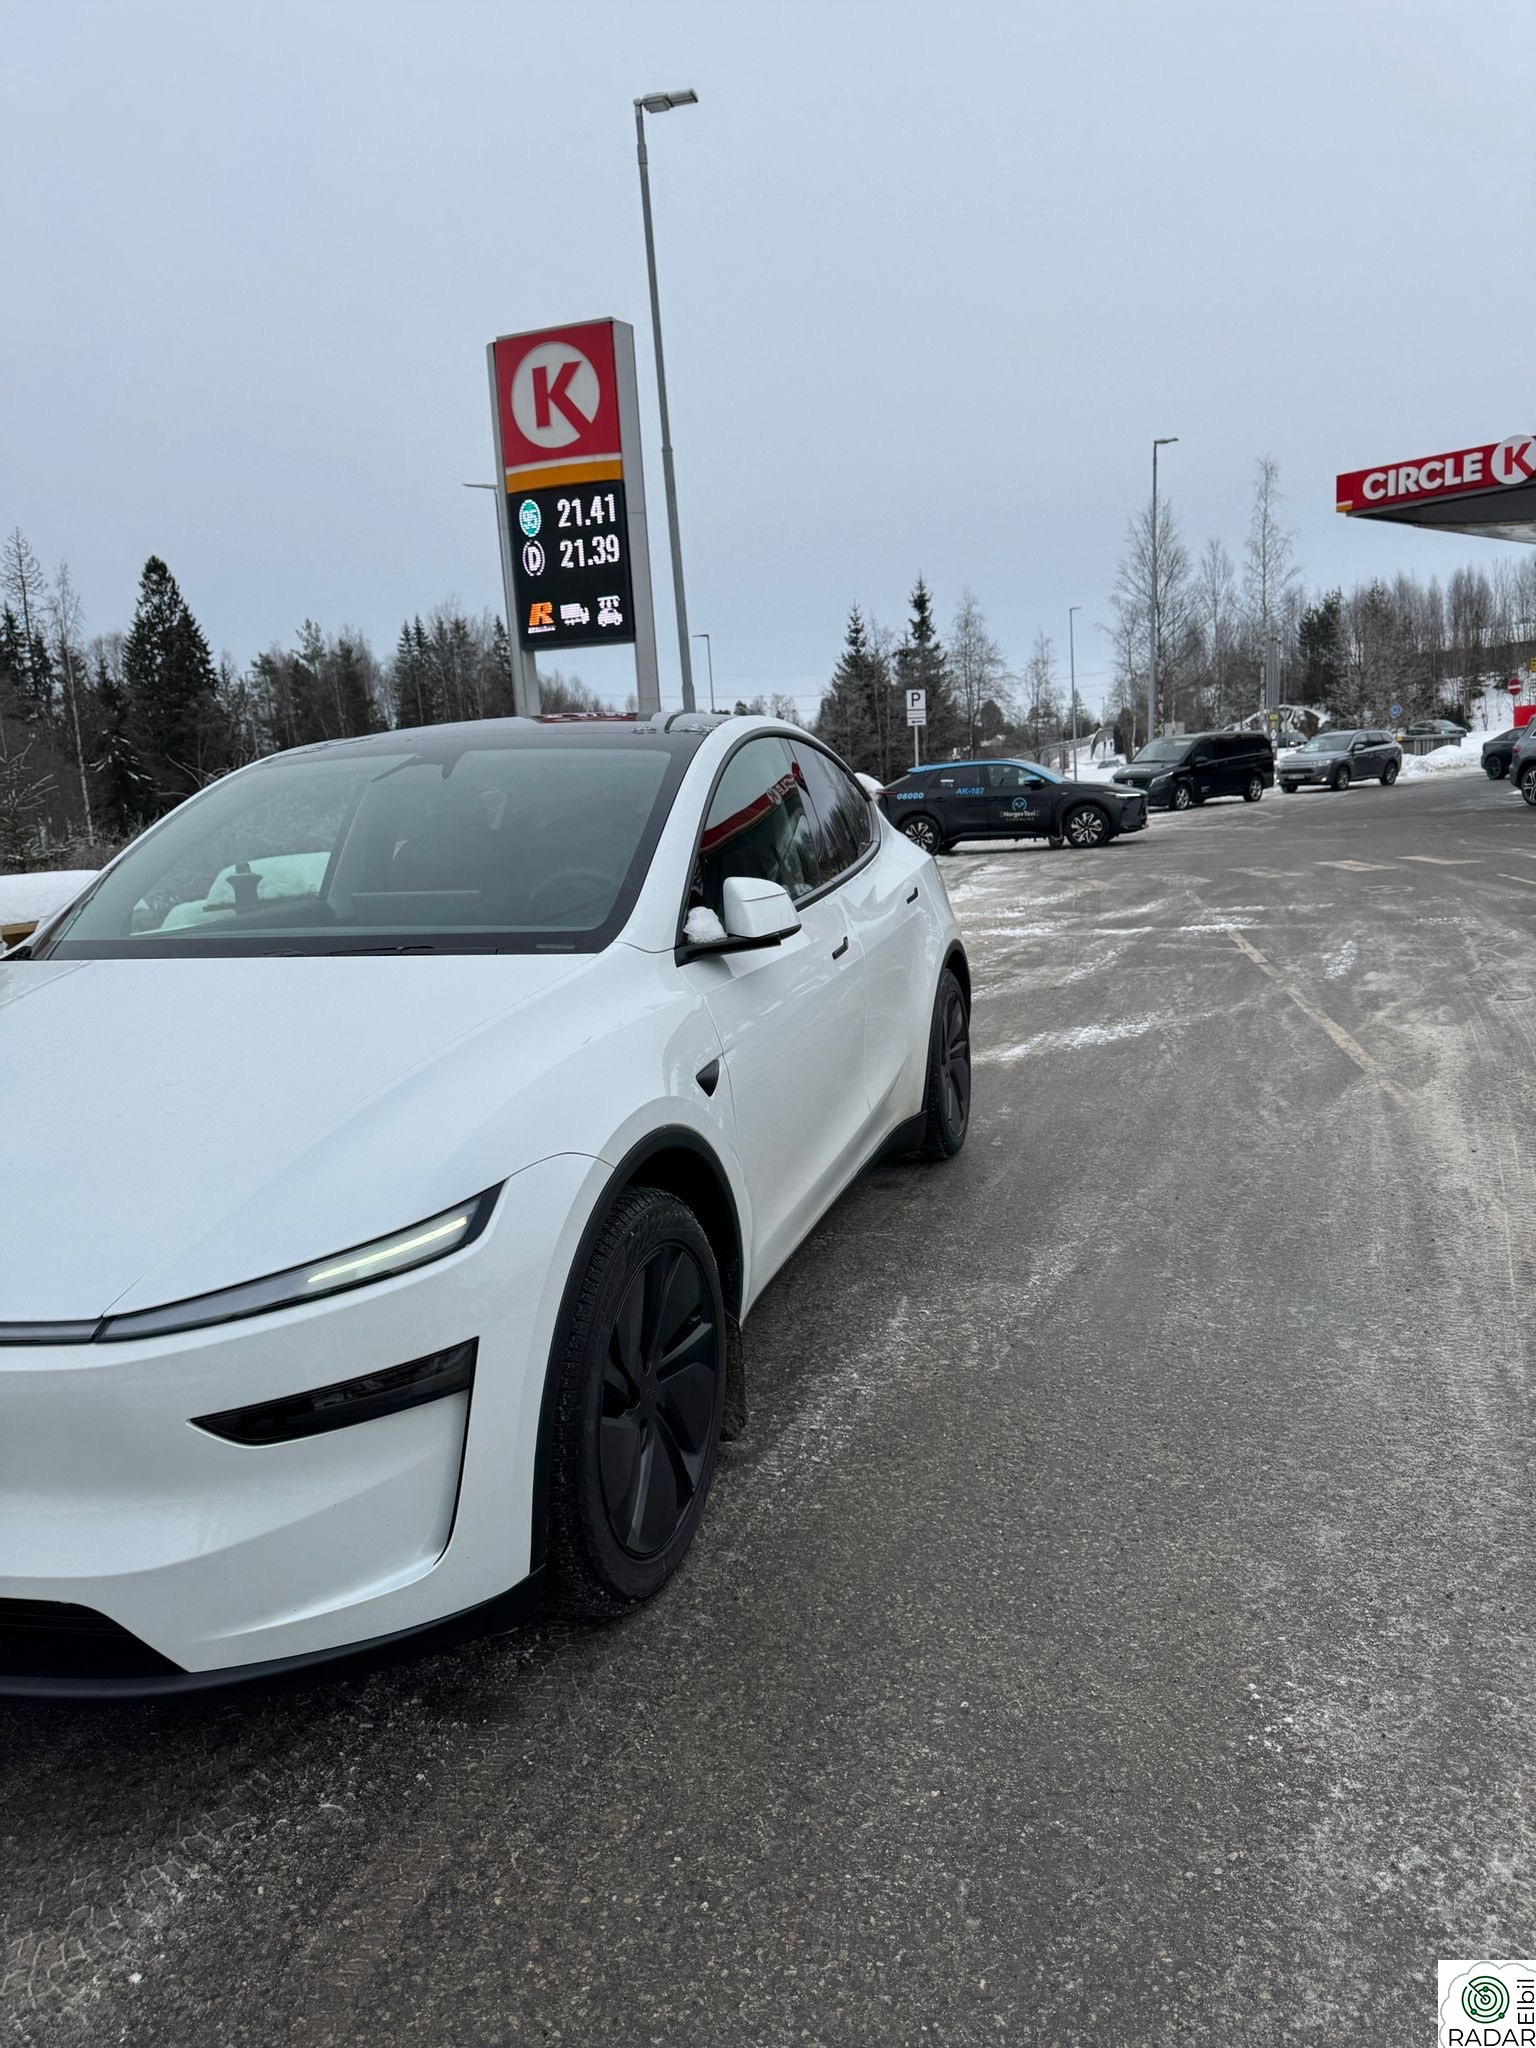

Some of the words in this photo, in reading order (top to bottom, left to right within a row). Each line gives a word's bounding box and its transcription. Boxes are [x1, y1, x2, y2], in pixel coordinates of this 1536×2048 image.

[530, 359, 593, 439] K
[1362, 452, 1484, 500] CIRCLE
[1502, 440, 1536, 481] K
[557, 494, 616, 528] 21.41
[528, 546, 542, 572] D
[560, 534, 620, 568] 21.39
[911, 692, 921, 707] P
